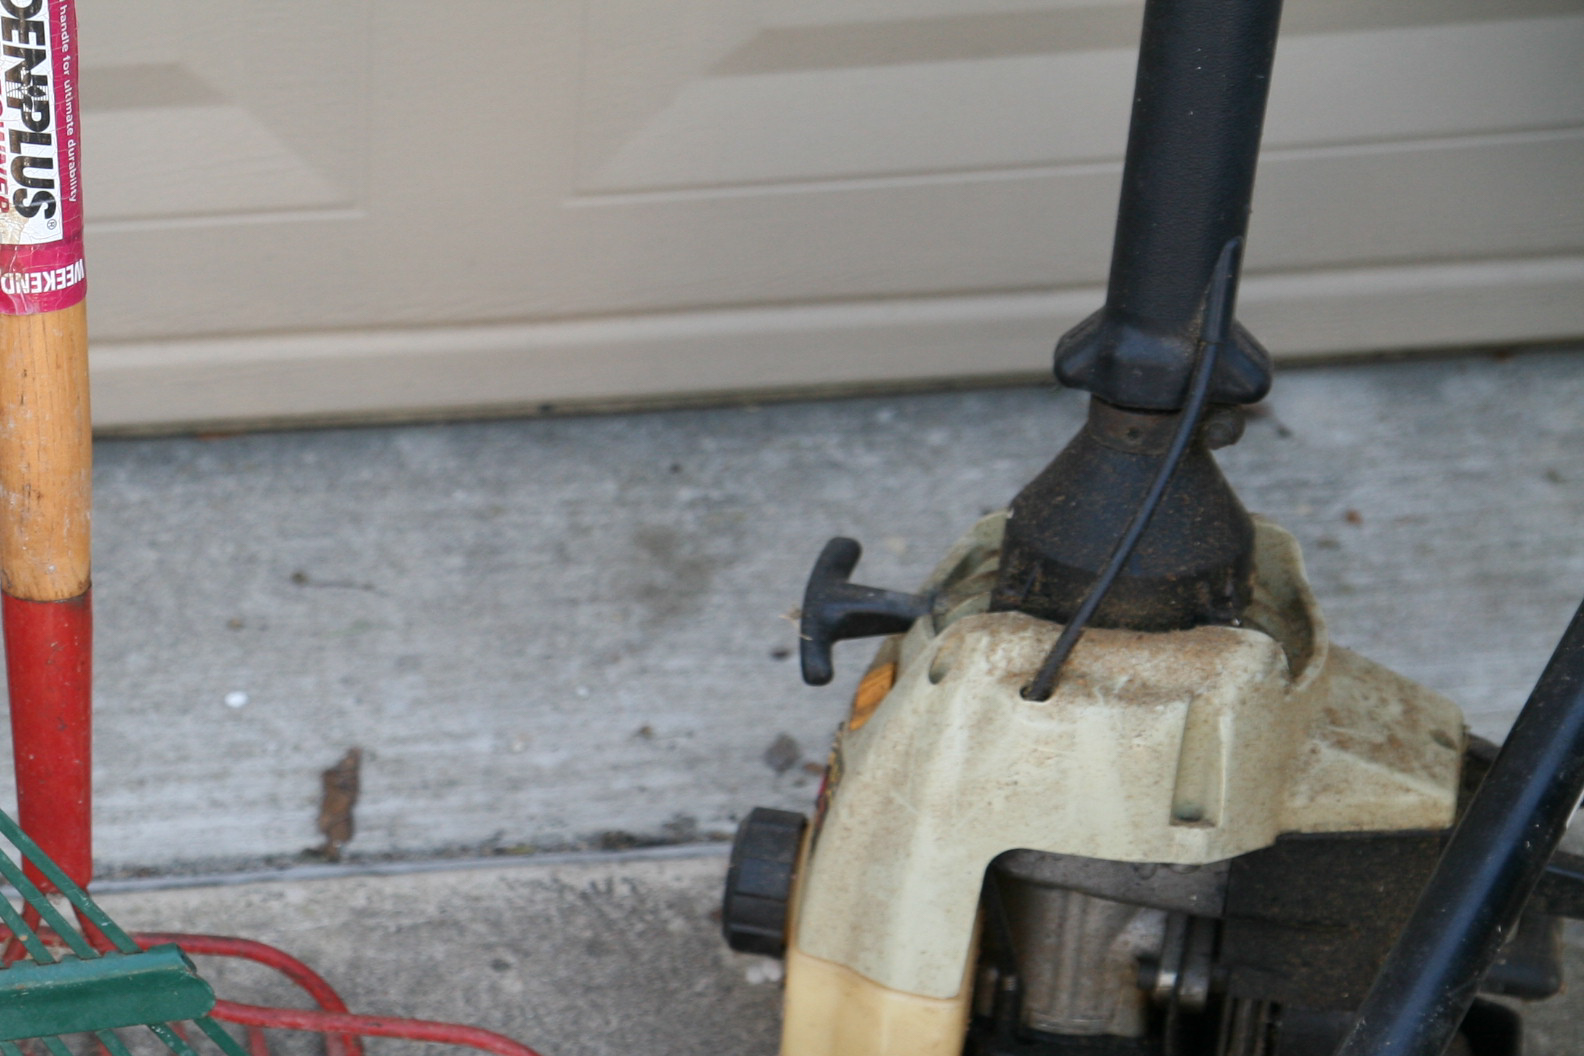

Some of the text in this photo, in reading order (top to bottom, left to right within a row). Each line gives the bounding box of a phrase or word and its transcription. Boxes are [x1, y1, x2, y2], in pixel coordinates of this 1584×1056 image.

[59, 5, 78, 202] handle for ultimate durability
[0, 259, 85, 295] WEEKEND
